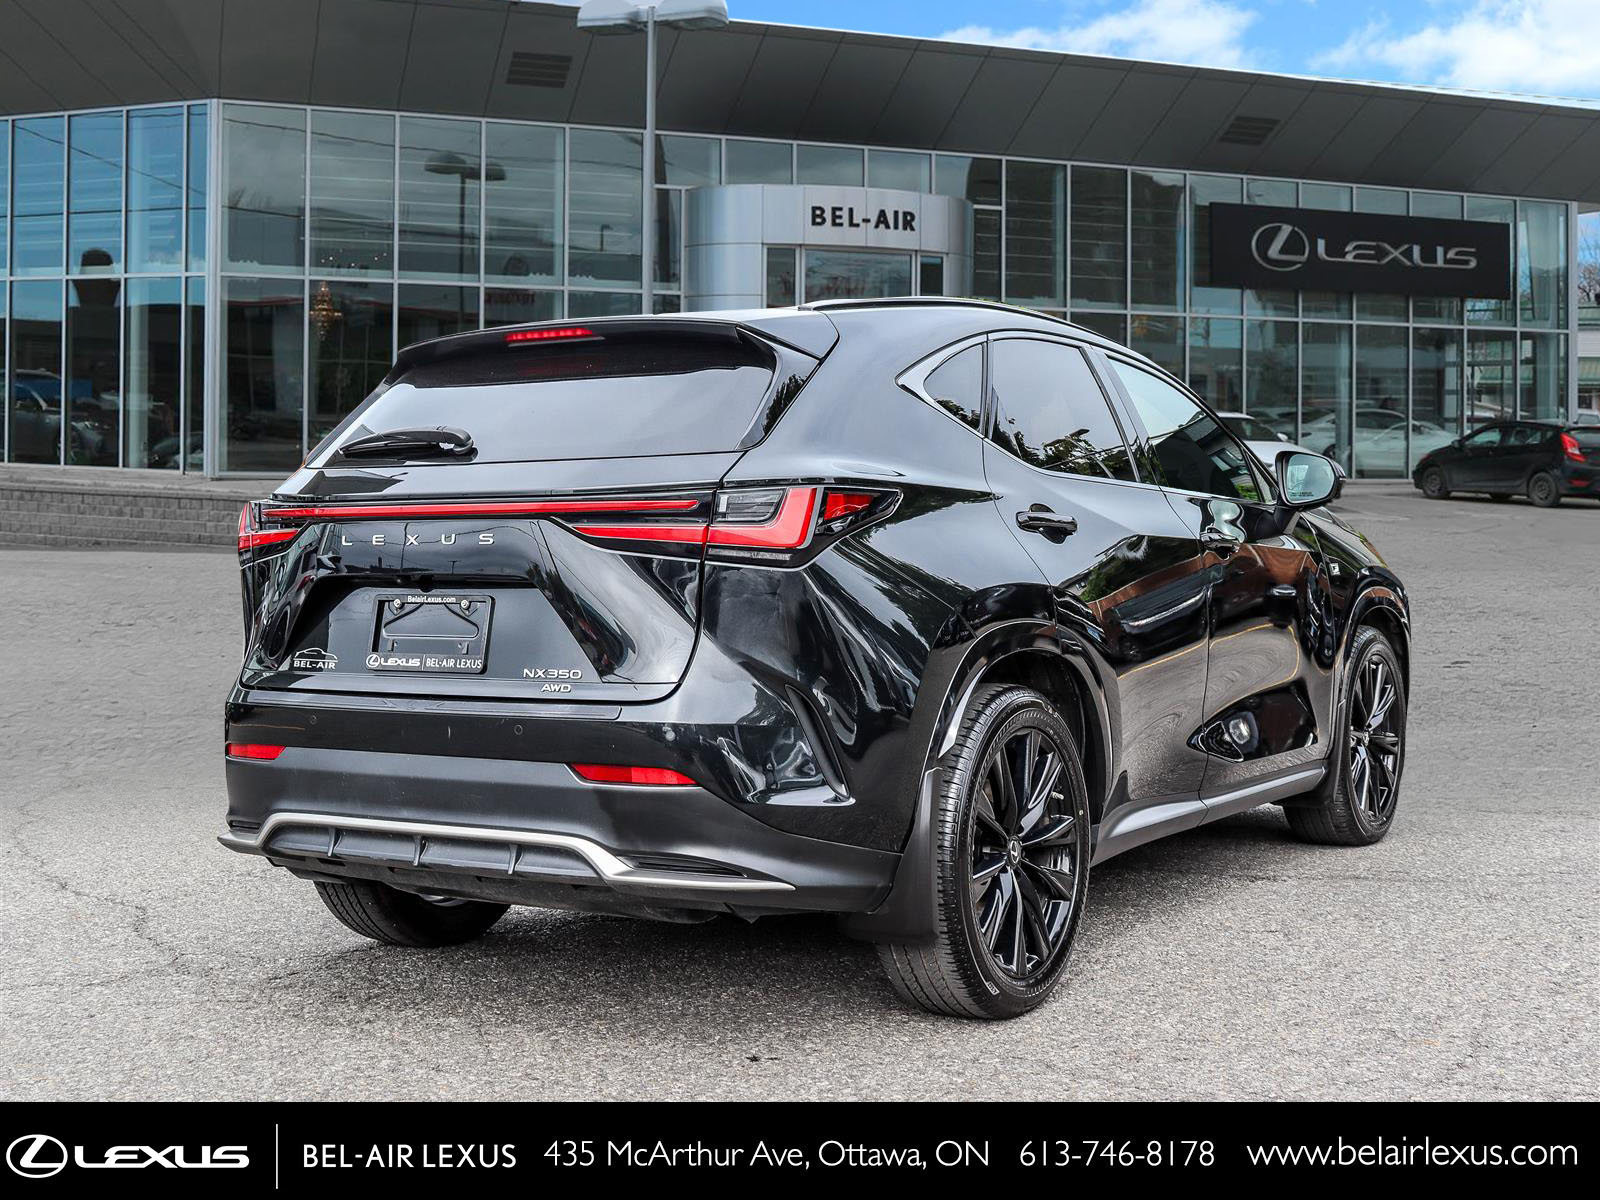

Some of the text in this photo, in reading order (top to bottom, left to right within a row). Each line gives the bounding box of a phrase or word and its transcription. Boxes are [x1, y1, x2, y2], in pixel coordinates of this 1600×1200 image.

[811, 206, 916, 232] BEL-AIR
[1317, 237, 1478, 269] LEXUS
[341, 533, 495, 546] LEXUS
[293, 660, 336, 670] BEL-AIR
[381, 657, 421, 667] LEXUS
[456, 659, 482, 669] LEXUS
[523, 668, 582, 679] NX350
[540, 683, 571, 693] AWD
